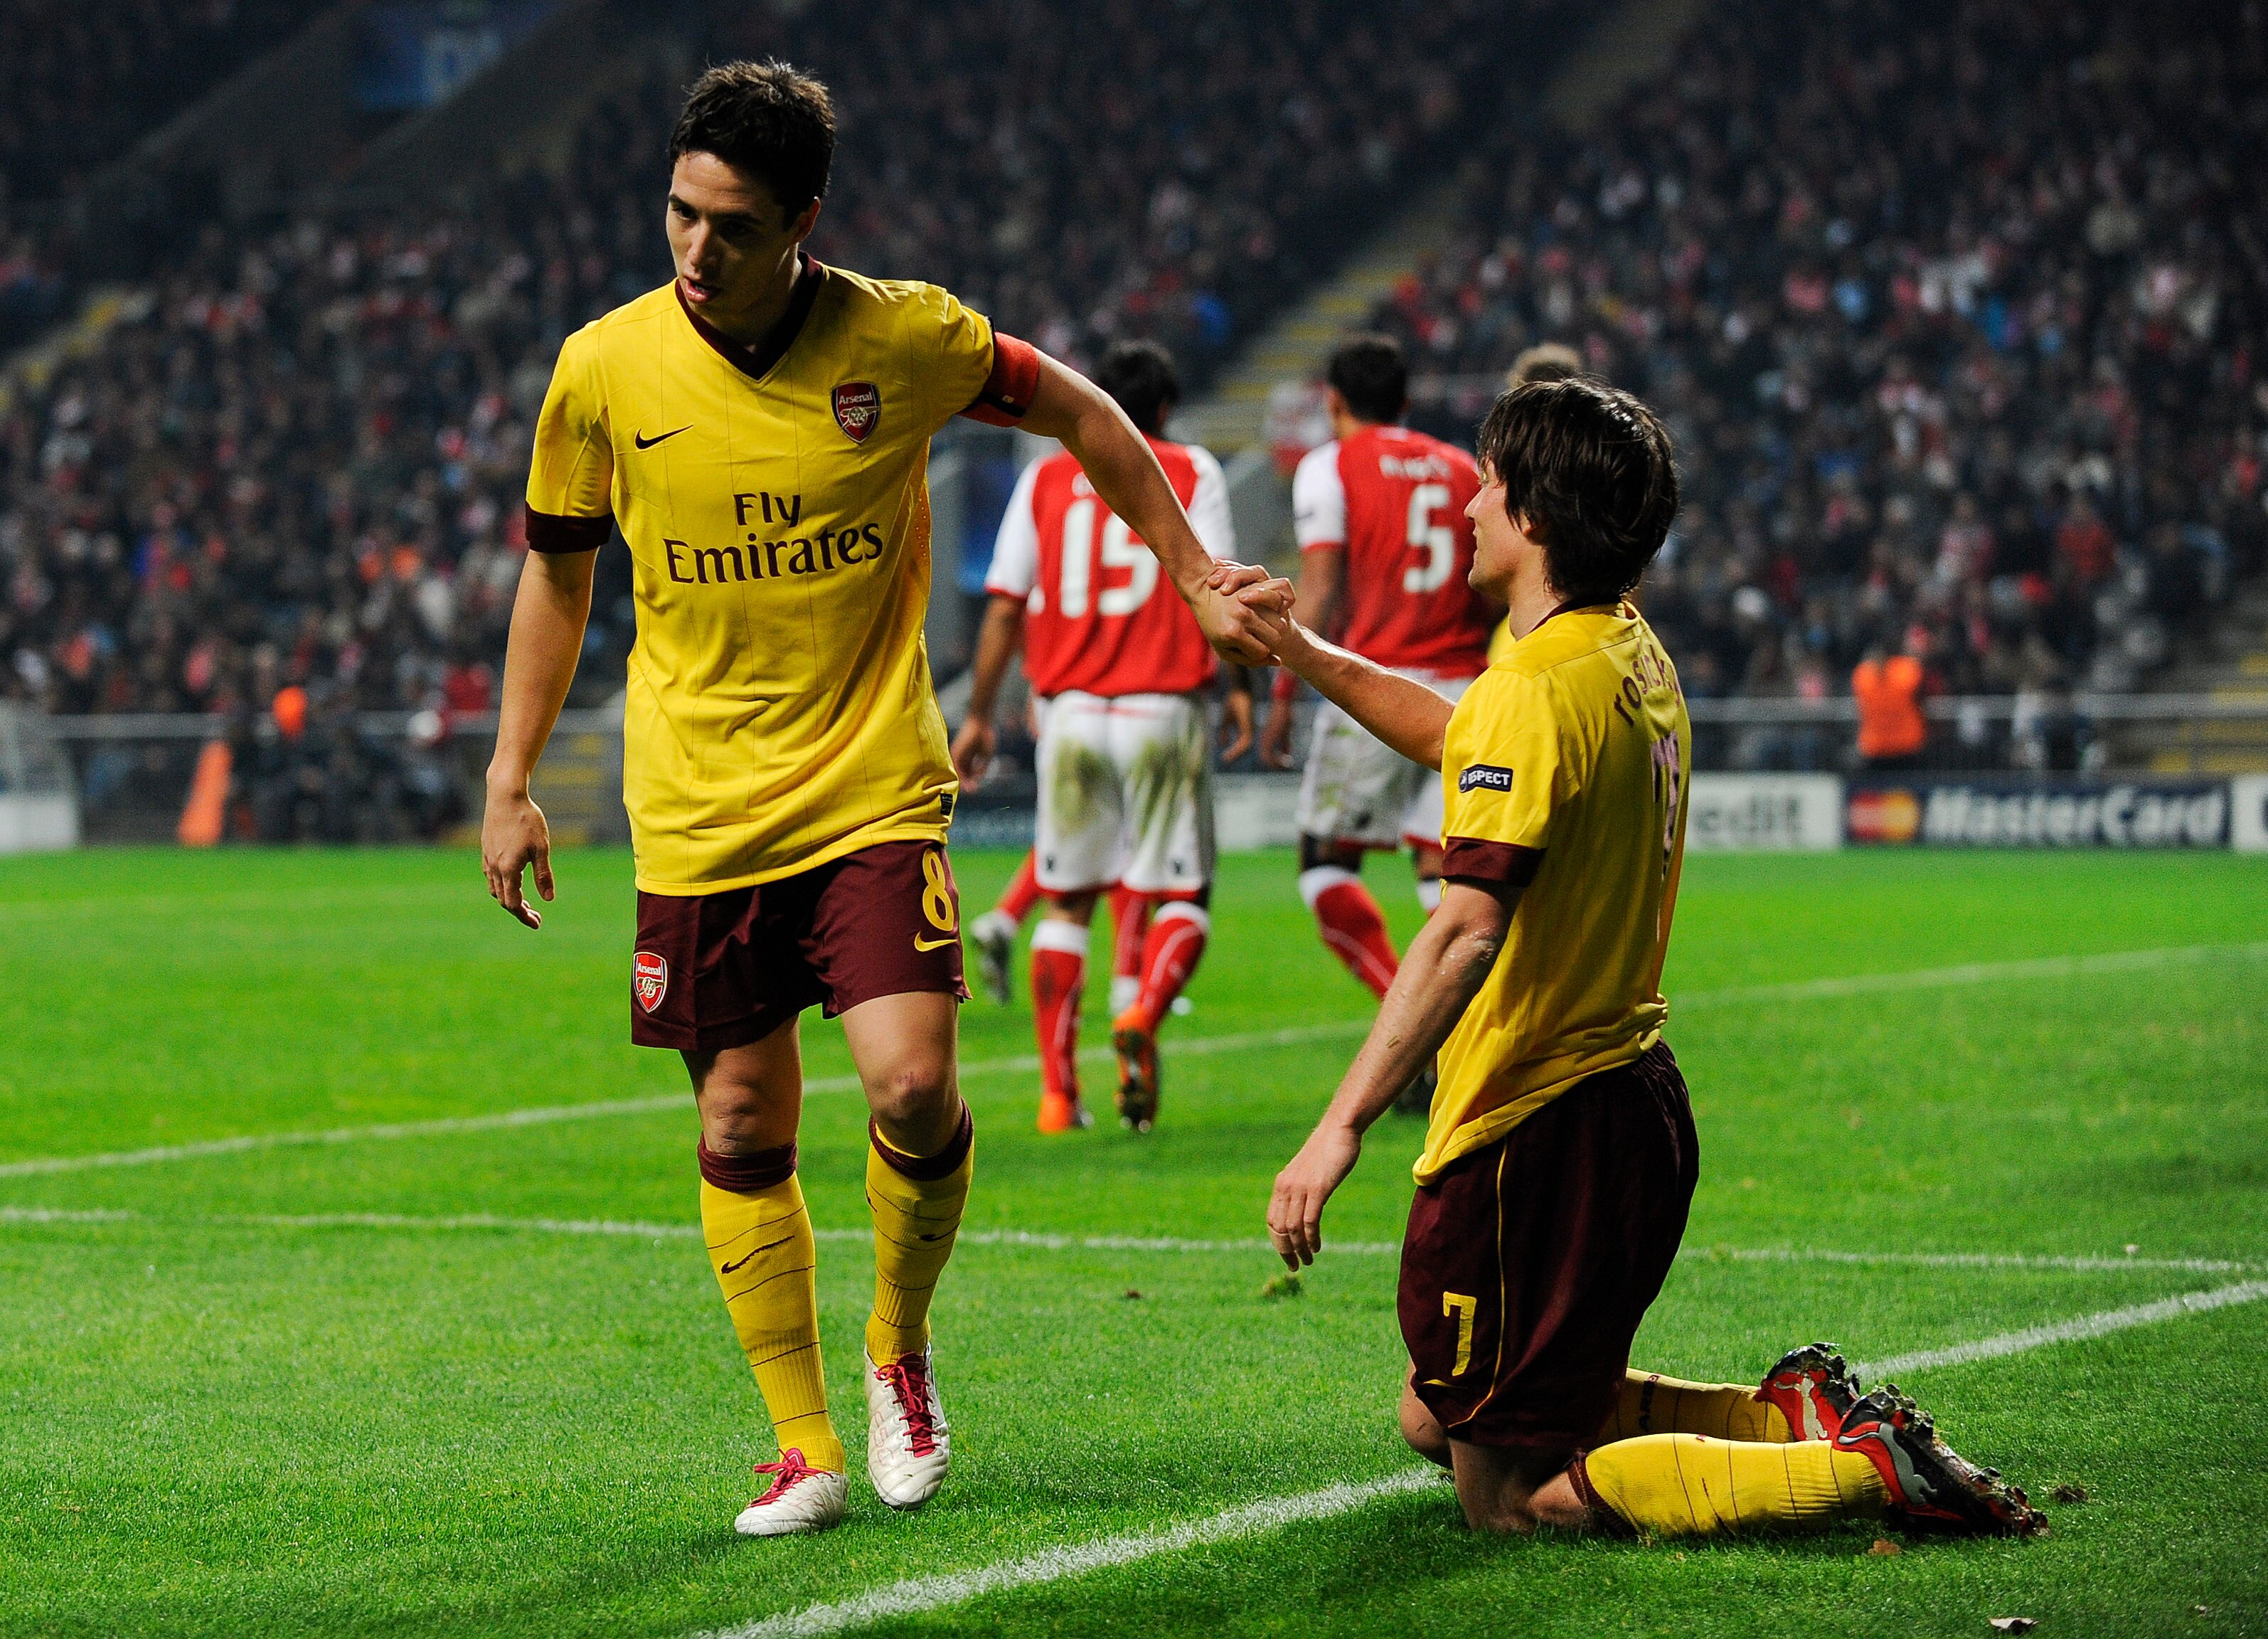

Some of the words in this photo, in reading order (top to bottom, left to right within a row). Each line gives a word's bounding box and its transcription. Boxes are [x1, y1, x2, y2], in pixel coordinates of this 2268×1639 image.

[839, 391, 873, 405] Arsenal
[733, 491, 802, 529] Fly
[1403, 484, 1455, 593] 5
[663, 522, 883, 584] Emirates
[1060, 498, 1160, 618] 15
[1923, 785, 2226, 844] MasterCard
[922, 848, 954, 932] 8
[637, 962, 661, 976] Arsenal
[1443, 1291, 1477, 1377] 7
